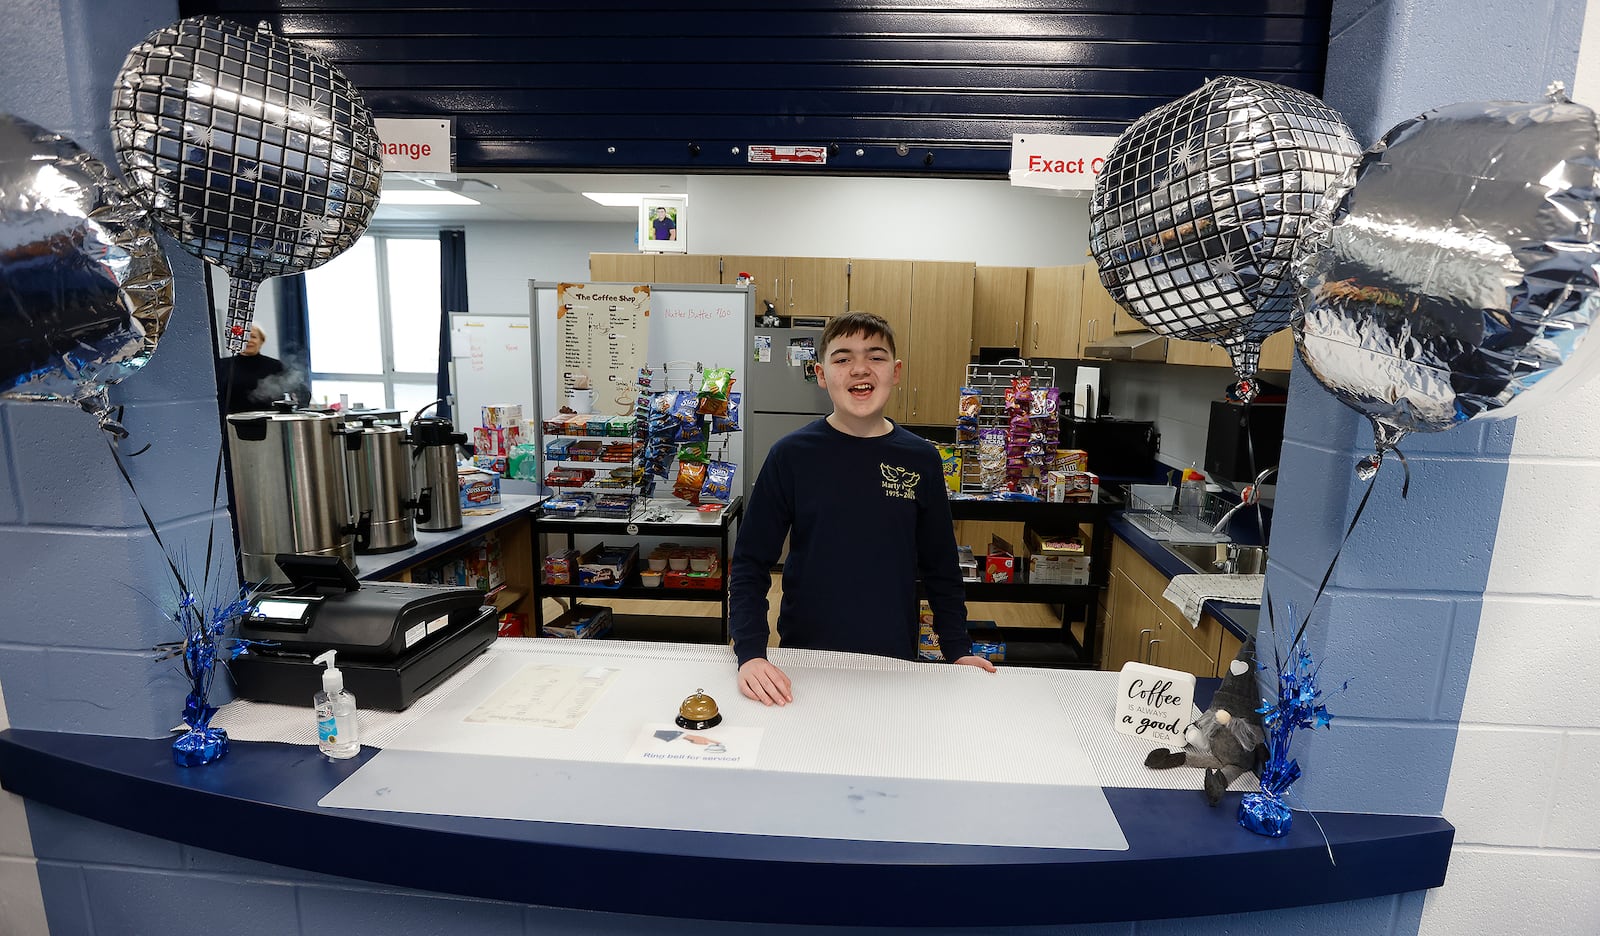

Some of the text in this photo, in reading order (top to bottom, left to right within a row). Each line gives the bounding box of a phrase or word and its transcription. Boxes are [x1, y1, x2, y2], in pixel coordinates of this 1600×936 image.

[1029, 155, 1084, 174] Exact
[576, 293, 636, 303] The Coffee Shop
[1128, 679, 1181, 708] Coffee
[1137, 706, 1168, 719] ALWAYS
[1122, 715, 1180, 735] a good
[1152, 731, 1170, 740] IDEA
[643, 752, 665, 760] Ring
